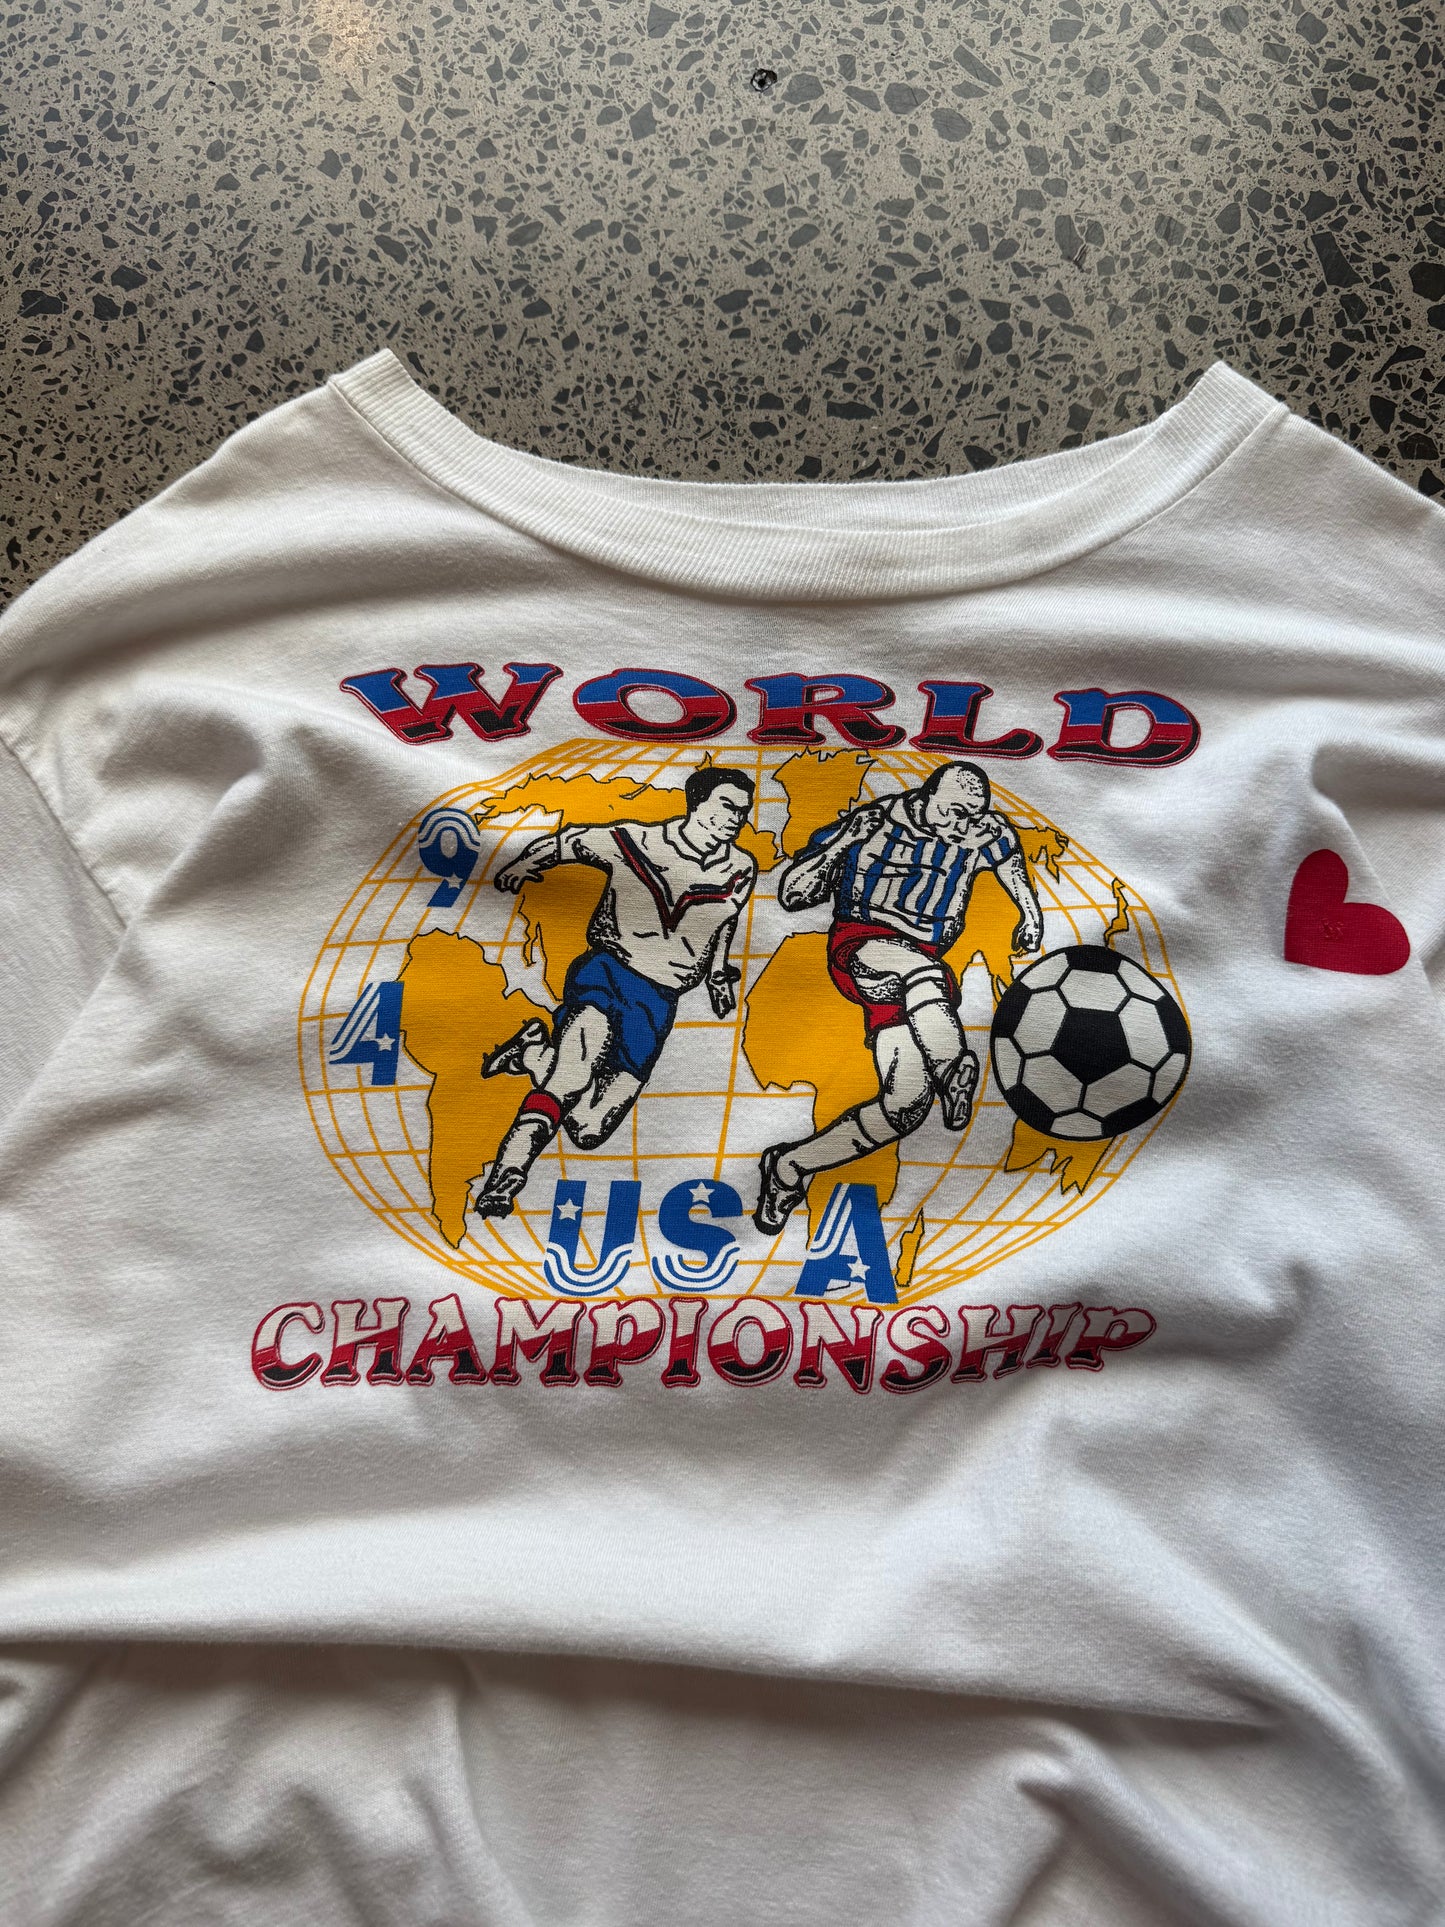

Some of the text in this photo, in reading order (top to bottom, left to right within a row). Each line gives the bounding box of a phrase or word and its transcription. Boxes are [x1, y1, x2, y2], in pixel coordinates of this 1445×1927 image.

[341, 662, 1202, 768] WORLD
[543, 1179, 899, 1304] USA
[251, 1294, 1157, 1394] CHAMPIONSHIP
